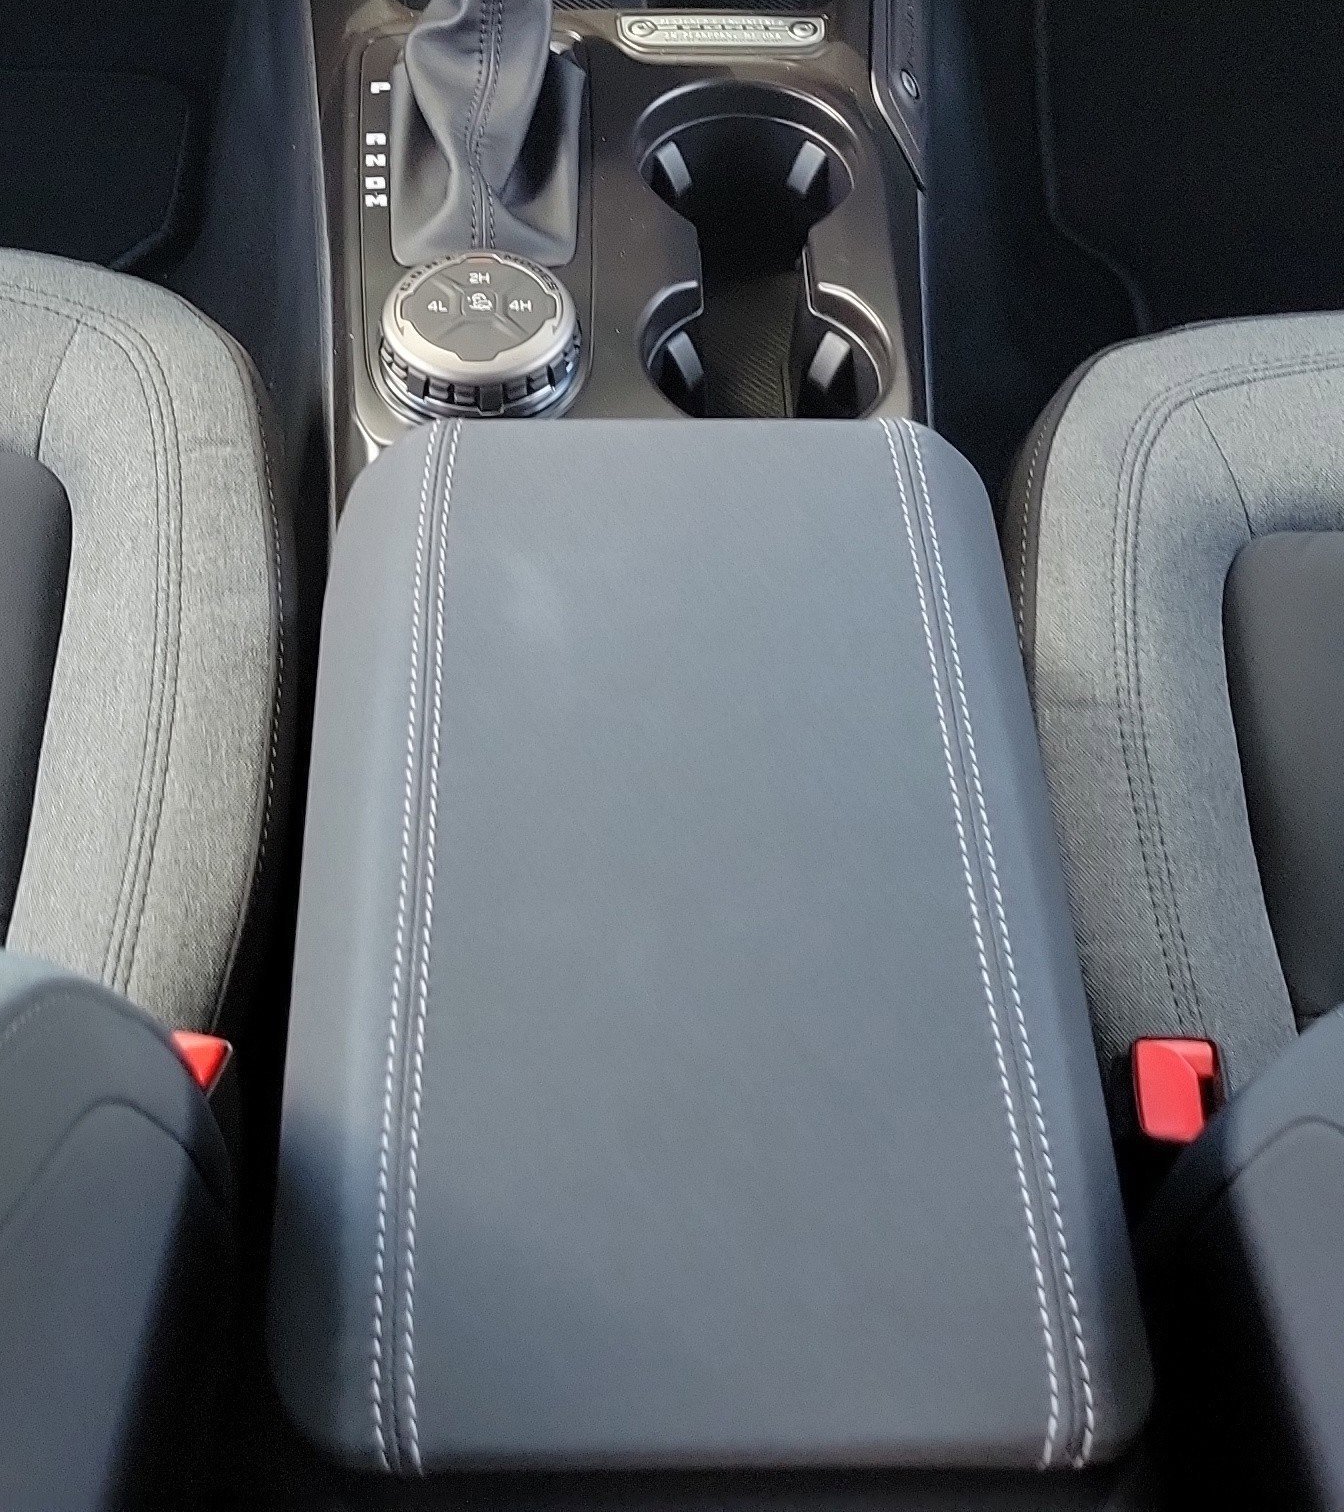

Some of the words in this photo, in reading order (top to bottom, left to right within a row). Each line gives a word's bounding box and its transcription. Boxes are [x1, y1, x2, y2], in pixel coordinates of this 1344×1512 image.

[370, 81, 391, 94] P
[365, 153, 387, 167] N
[364, 176, 386, 190] D
[364, 192, 388, 208] M
[468, 271, 491, 285] 2H
[427, 299, 449, 313] 4L
[508, 298, 533, 313] 4H
